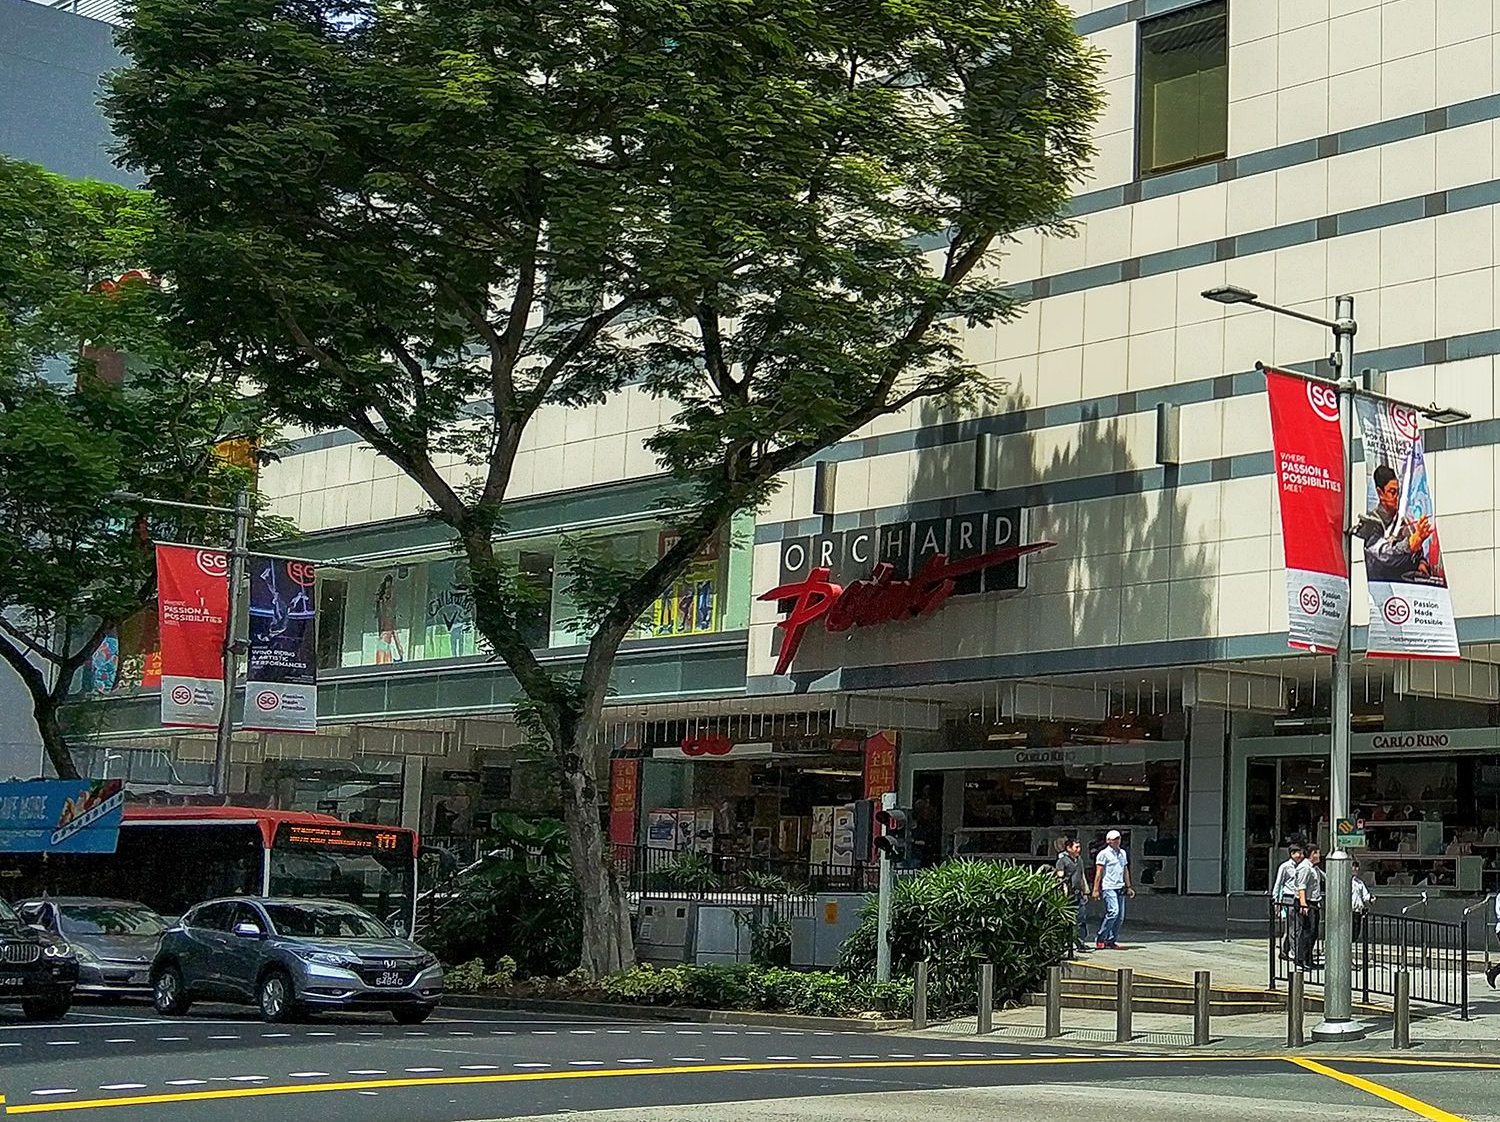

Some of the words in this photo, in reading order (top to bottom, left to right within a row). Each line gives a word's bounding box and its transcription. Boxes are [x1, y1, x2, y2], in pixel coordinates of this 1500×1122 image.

[1312, 385, 1337, 408] SG
[1281, 461, 1321, 477] PASSION
[1323, 468, 1329, 478] &
[1282, 472, 1341, 492] POSSIBILITIES
[784, 515, 1013, 572] ORCHARD
[201, 553, 228, 568] SG
[291, 562, 315, 578] SG
[163, 605, 201, 614] PASSION
[1388, 605, 1407, 617] SG
[1413, 600, 1439, 609] Passion
[1414, 609, 1433, 617] Made
[164, 613, 222, 624] POSSIBILITIES
[1414, 617, 1443, 626] Possible
[1373, 735, 1415, 749] CARLO
[1417, 734, 1449, 747] RINO
[376, 833, 397, 849] 111
[382, 972, 399, 980] SLH
